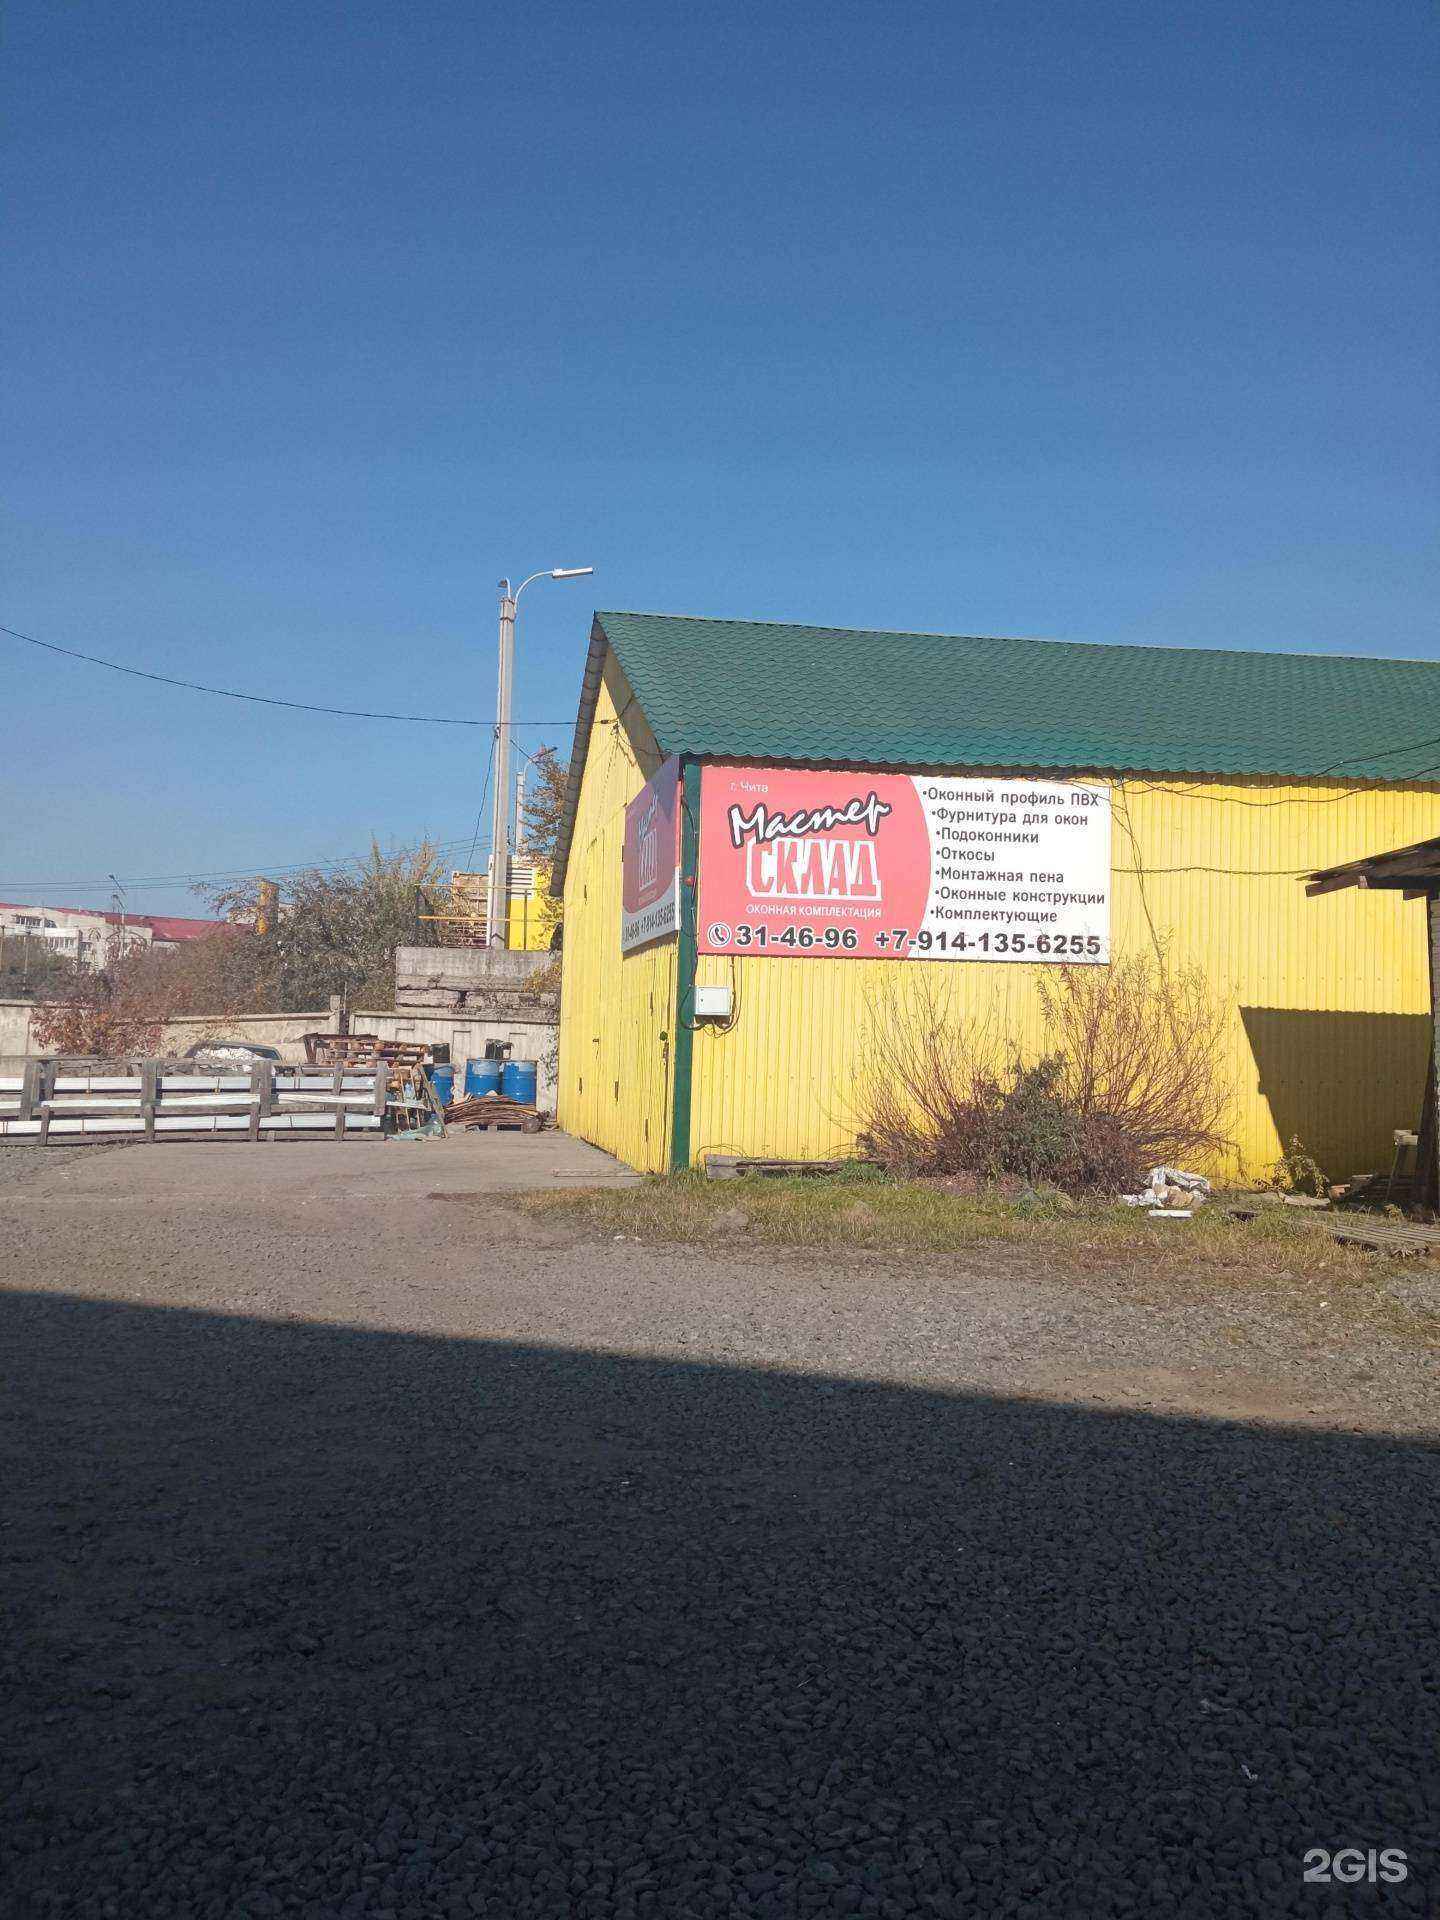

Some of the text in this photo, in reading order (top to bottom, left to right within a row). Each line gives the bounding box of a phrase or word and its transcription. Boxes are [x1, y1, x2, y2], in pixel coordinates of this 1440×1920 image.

[928, 786, 1099, 806] Оконный профиль ПВХ
[728, 791, 892, 848] Мастер
[937, 807, 1088, 825] Фурнитура для окон
[941, 827, 1039, 843] Подоконники
[941, 847, 995, 861] Откосы
[746, 836, 882, 901] СКЛАД
[941, 867, 1064, 883] Монтажная пена
[941, 887, 1105, 905] Оконные конструкции
[746, 904, 881, 920] ОКОННАЯ КОМПЛЕКТАЦИЯ
[936, 907, 1057, 923] Комплектующие
[736, 925, 1101, 955] 31-46-96 +7-914-135-6255
